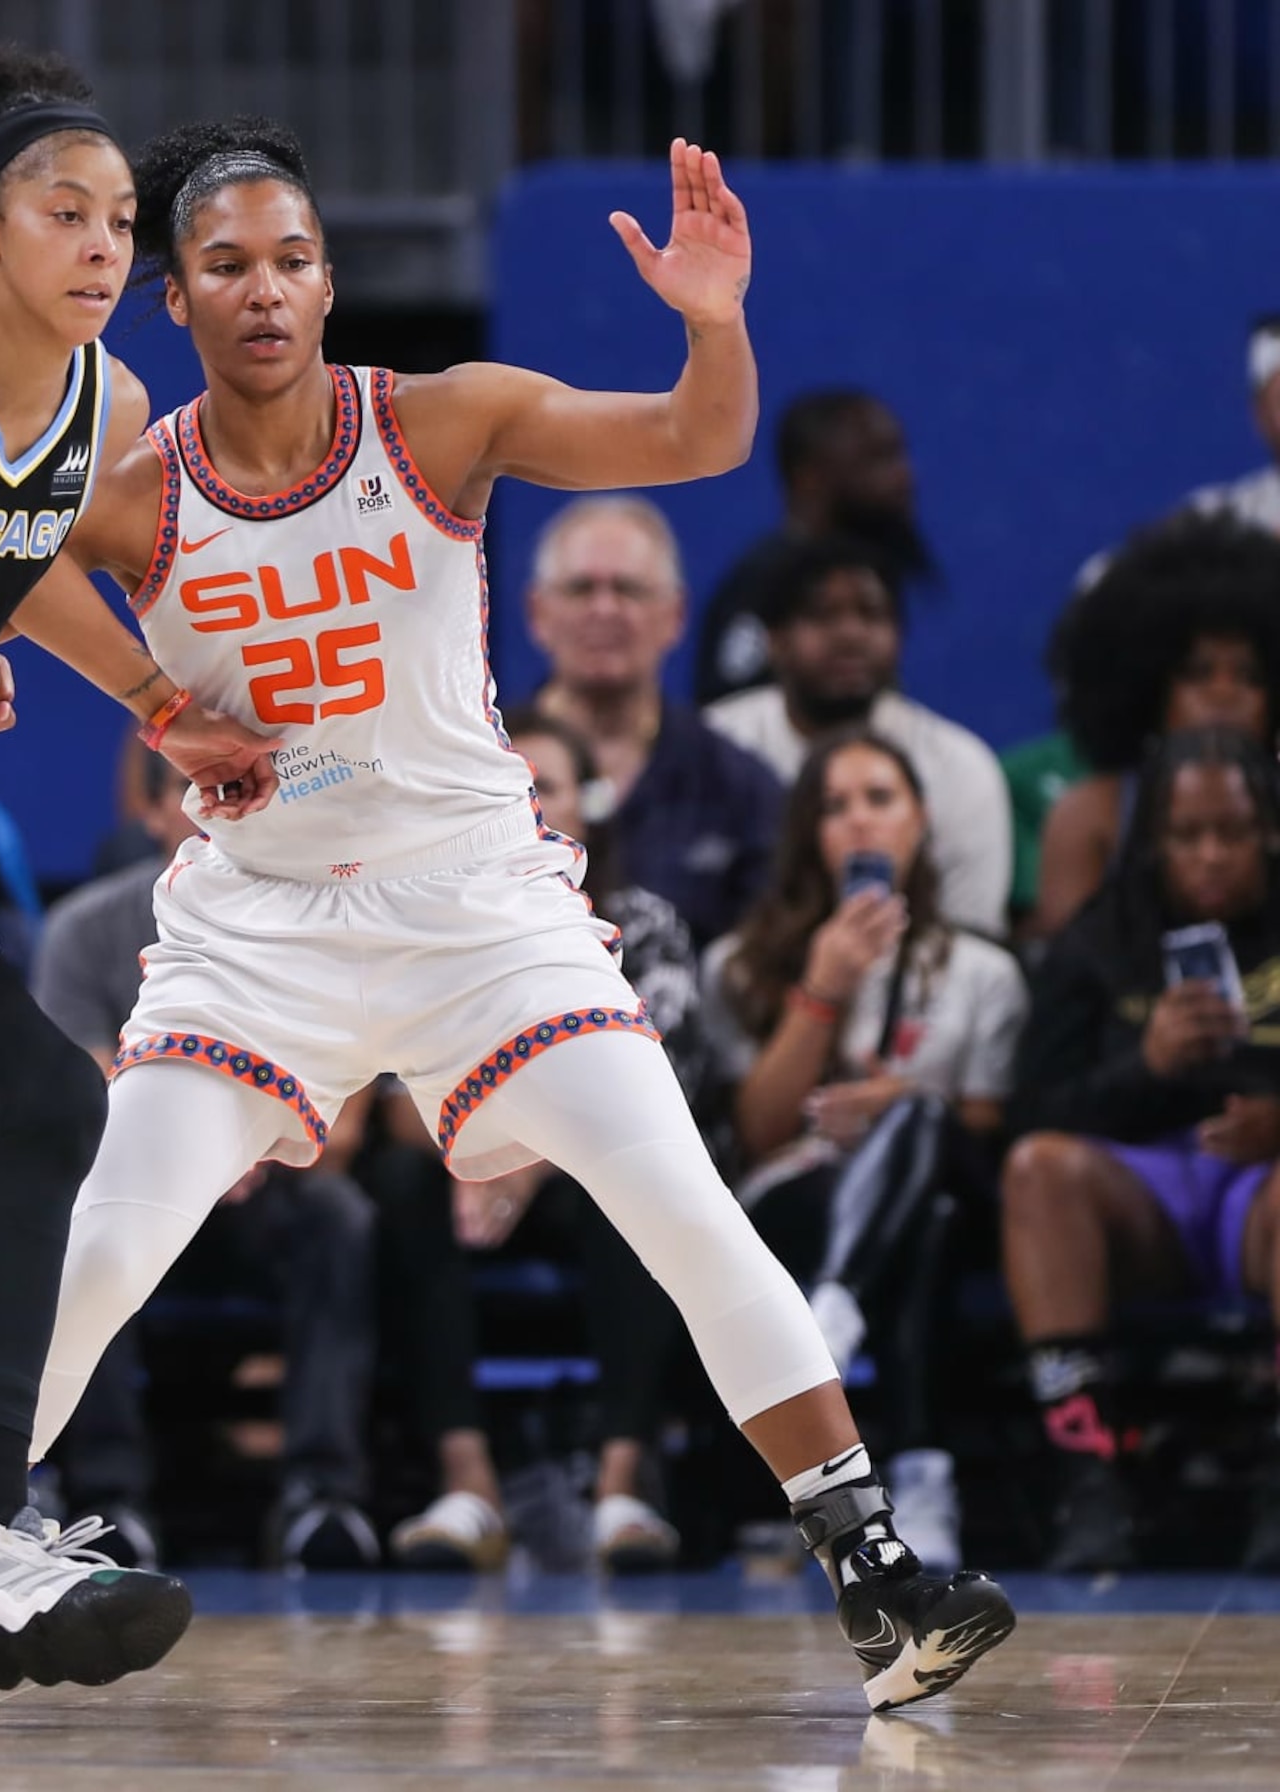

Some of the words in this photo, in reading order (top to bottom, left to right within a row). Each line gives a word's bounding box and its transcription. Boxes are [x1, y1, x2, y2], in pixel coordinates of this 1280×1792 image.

[356, 493, 391, 510] Post
[179, 531, 417, 633] SUN
[241, 621, 387, 726] 25
[270, 745, 310, 766] Yale
[279, 764, 354, 804] Health
